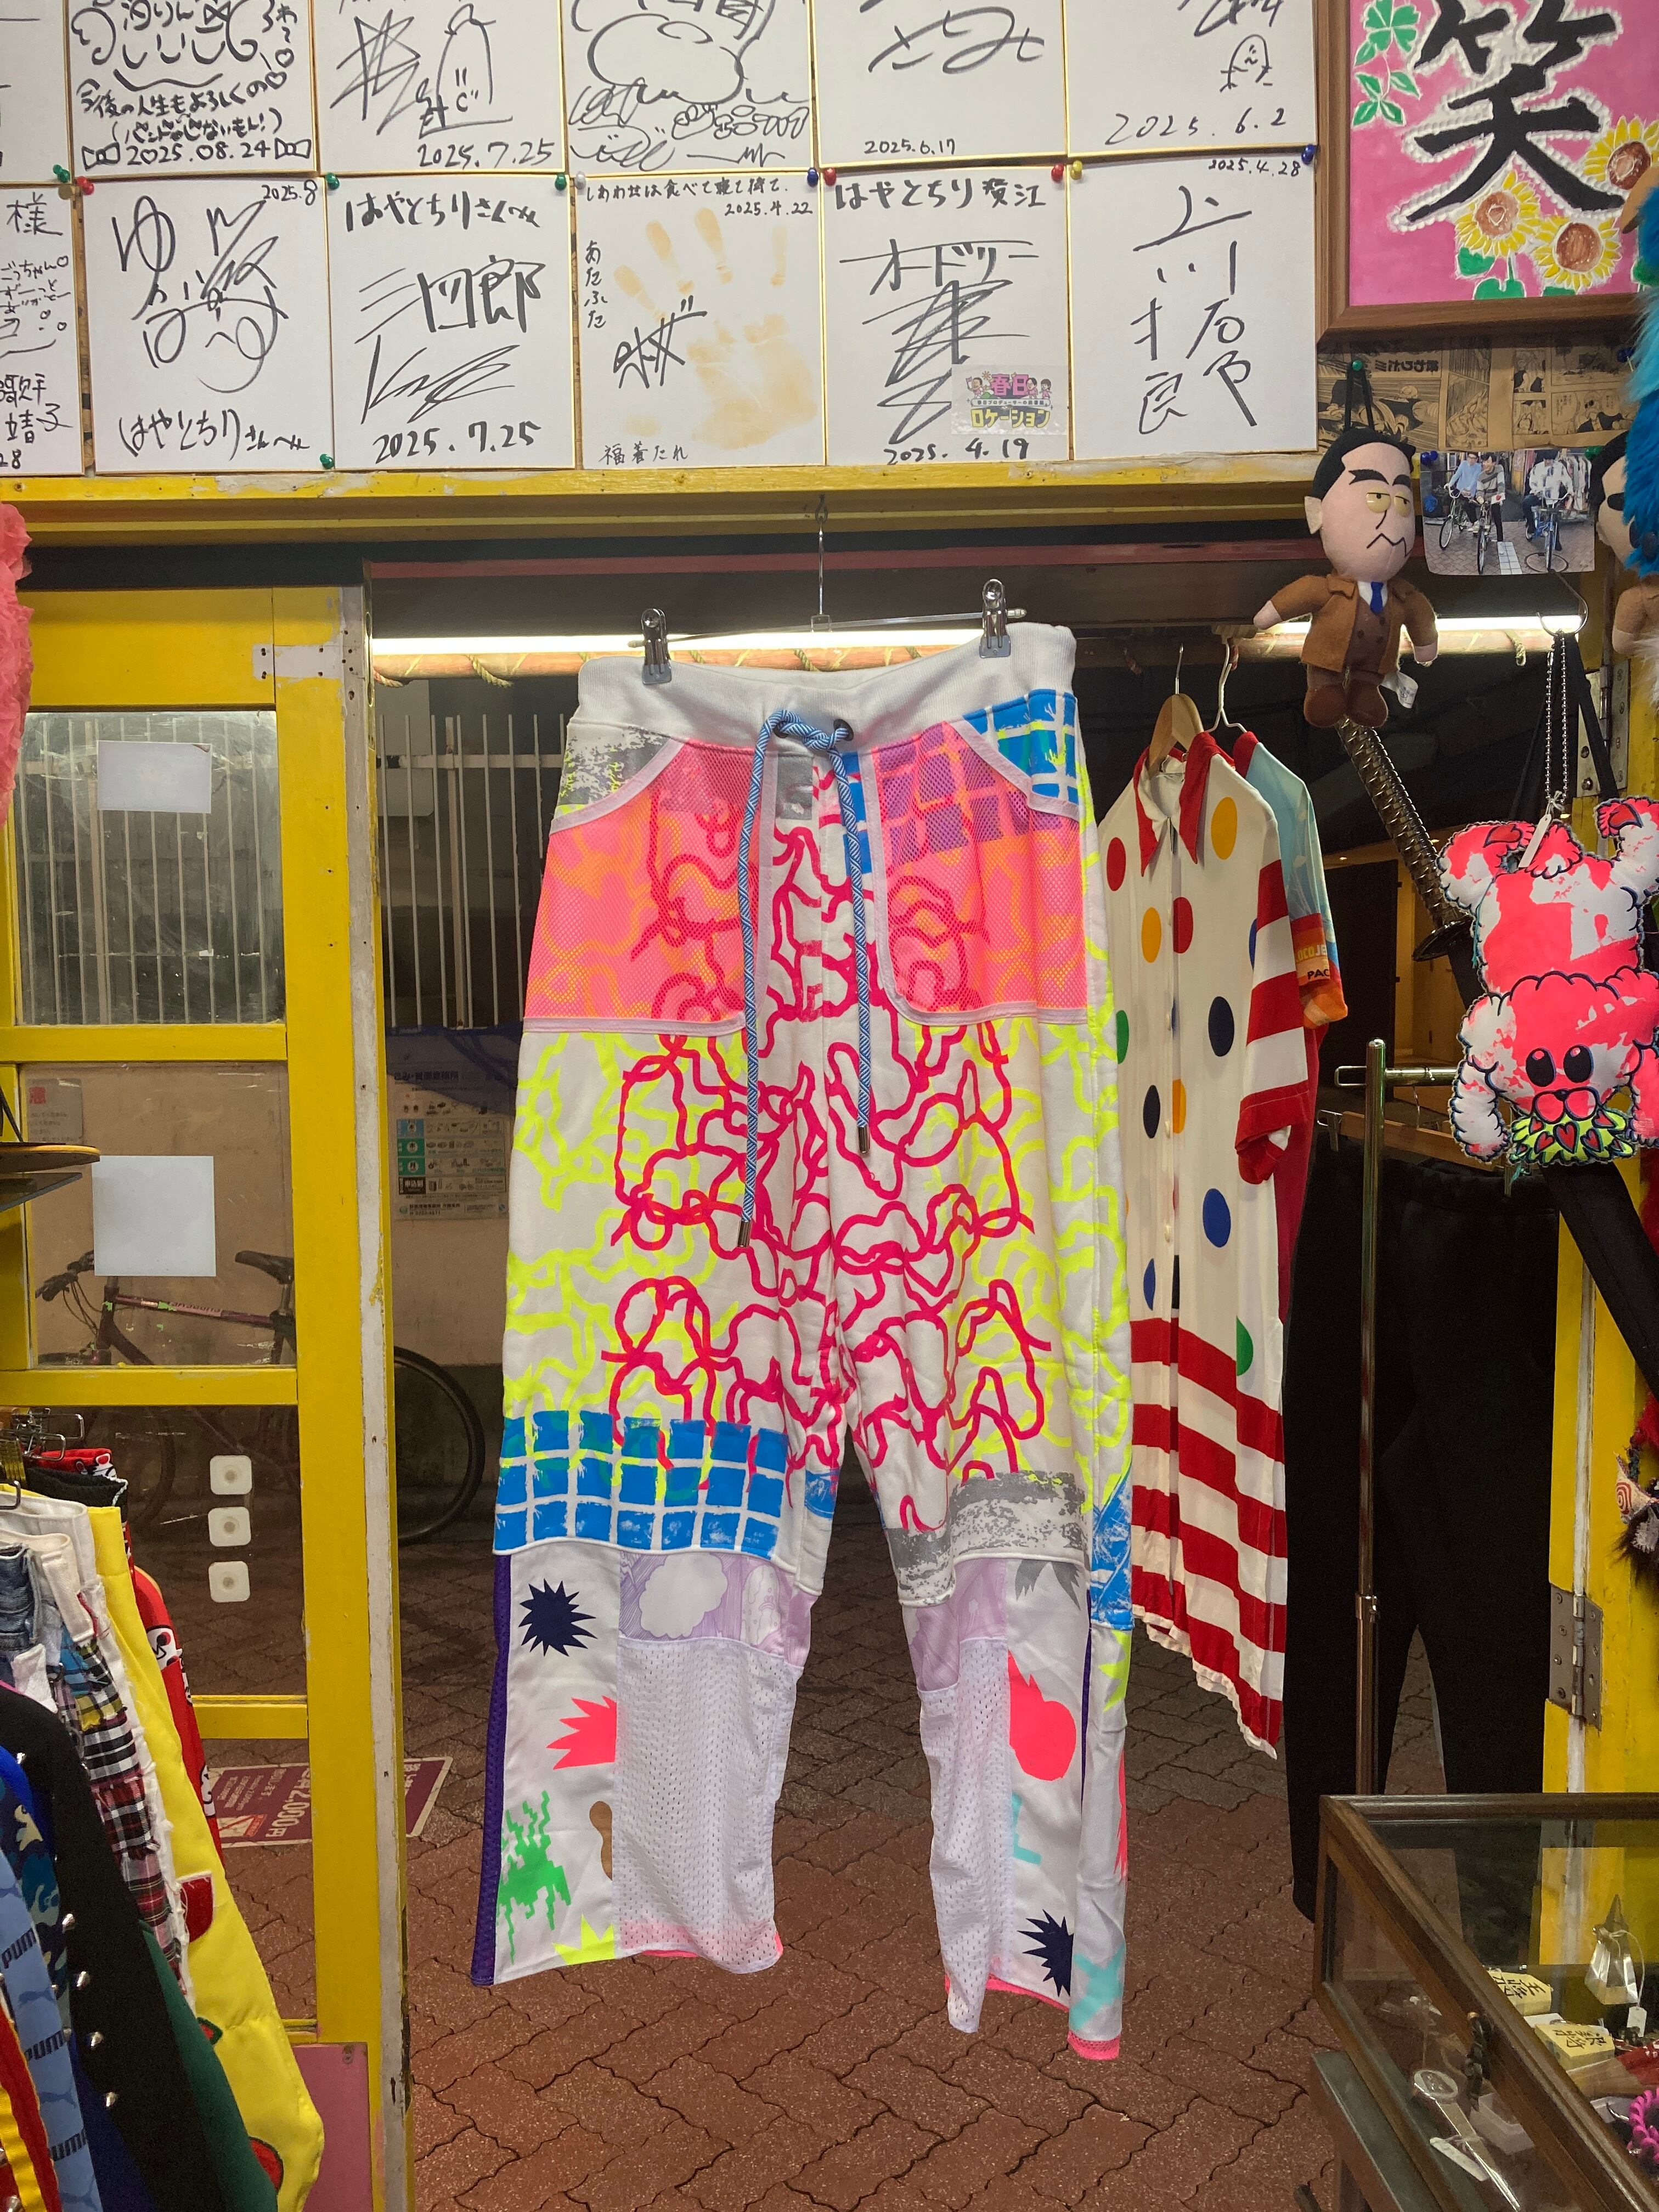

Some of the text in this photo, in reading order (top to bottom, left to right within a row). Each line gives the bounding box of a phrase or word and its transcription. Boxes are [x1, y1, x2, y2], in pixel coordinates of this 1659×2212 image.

[1406, 0, 1625, 222] 笑
[865, 138, 955, 155] 2025.6.17
[1208, 158, 1300, 177] 2025.4.28
[262, 179, 318, 205] 2025.8
[7, 192, 63, 235] 様
[725, 202, 813, 216] 2025.4.22
[584, 240, 607, 329] あたふた
[354, 255, 546, 343] 三四郎
[990, 373, 1029, 396] 春日
[970, 409, 1050, 428] ロケーション
[373, 421, 541, 464] 2025.7.25
